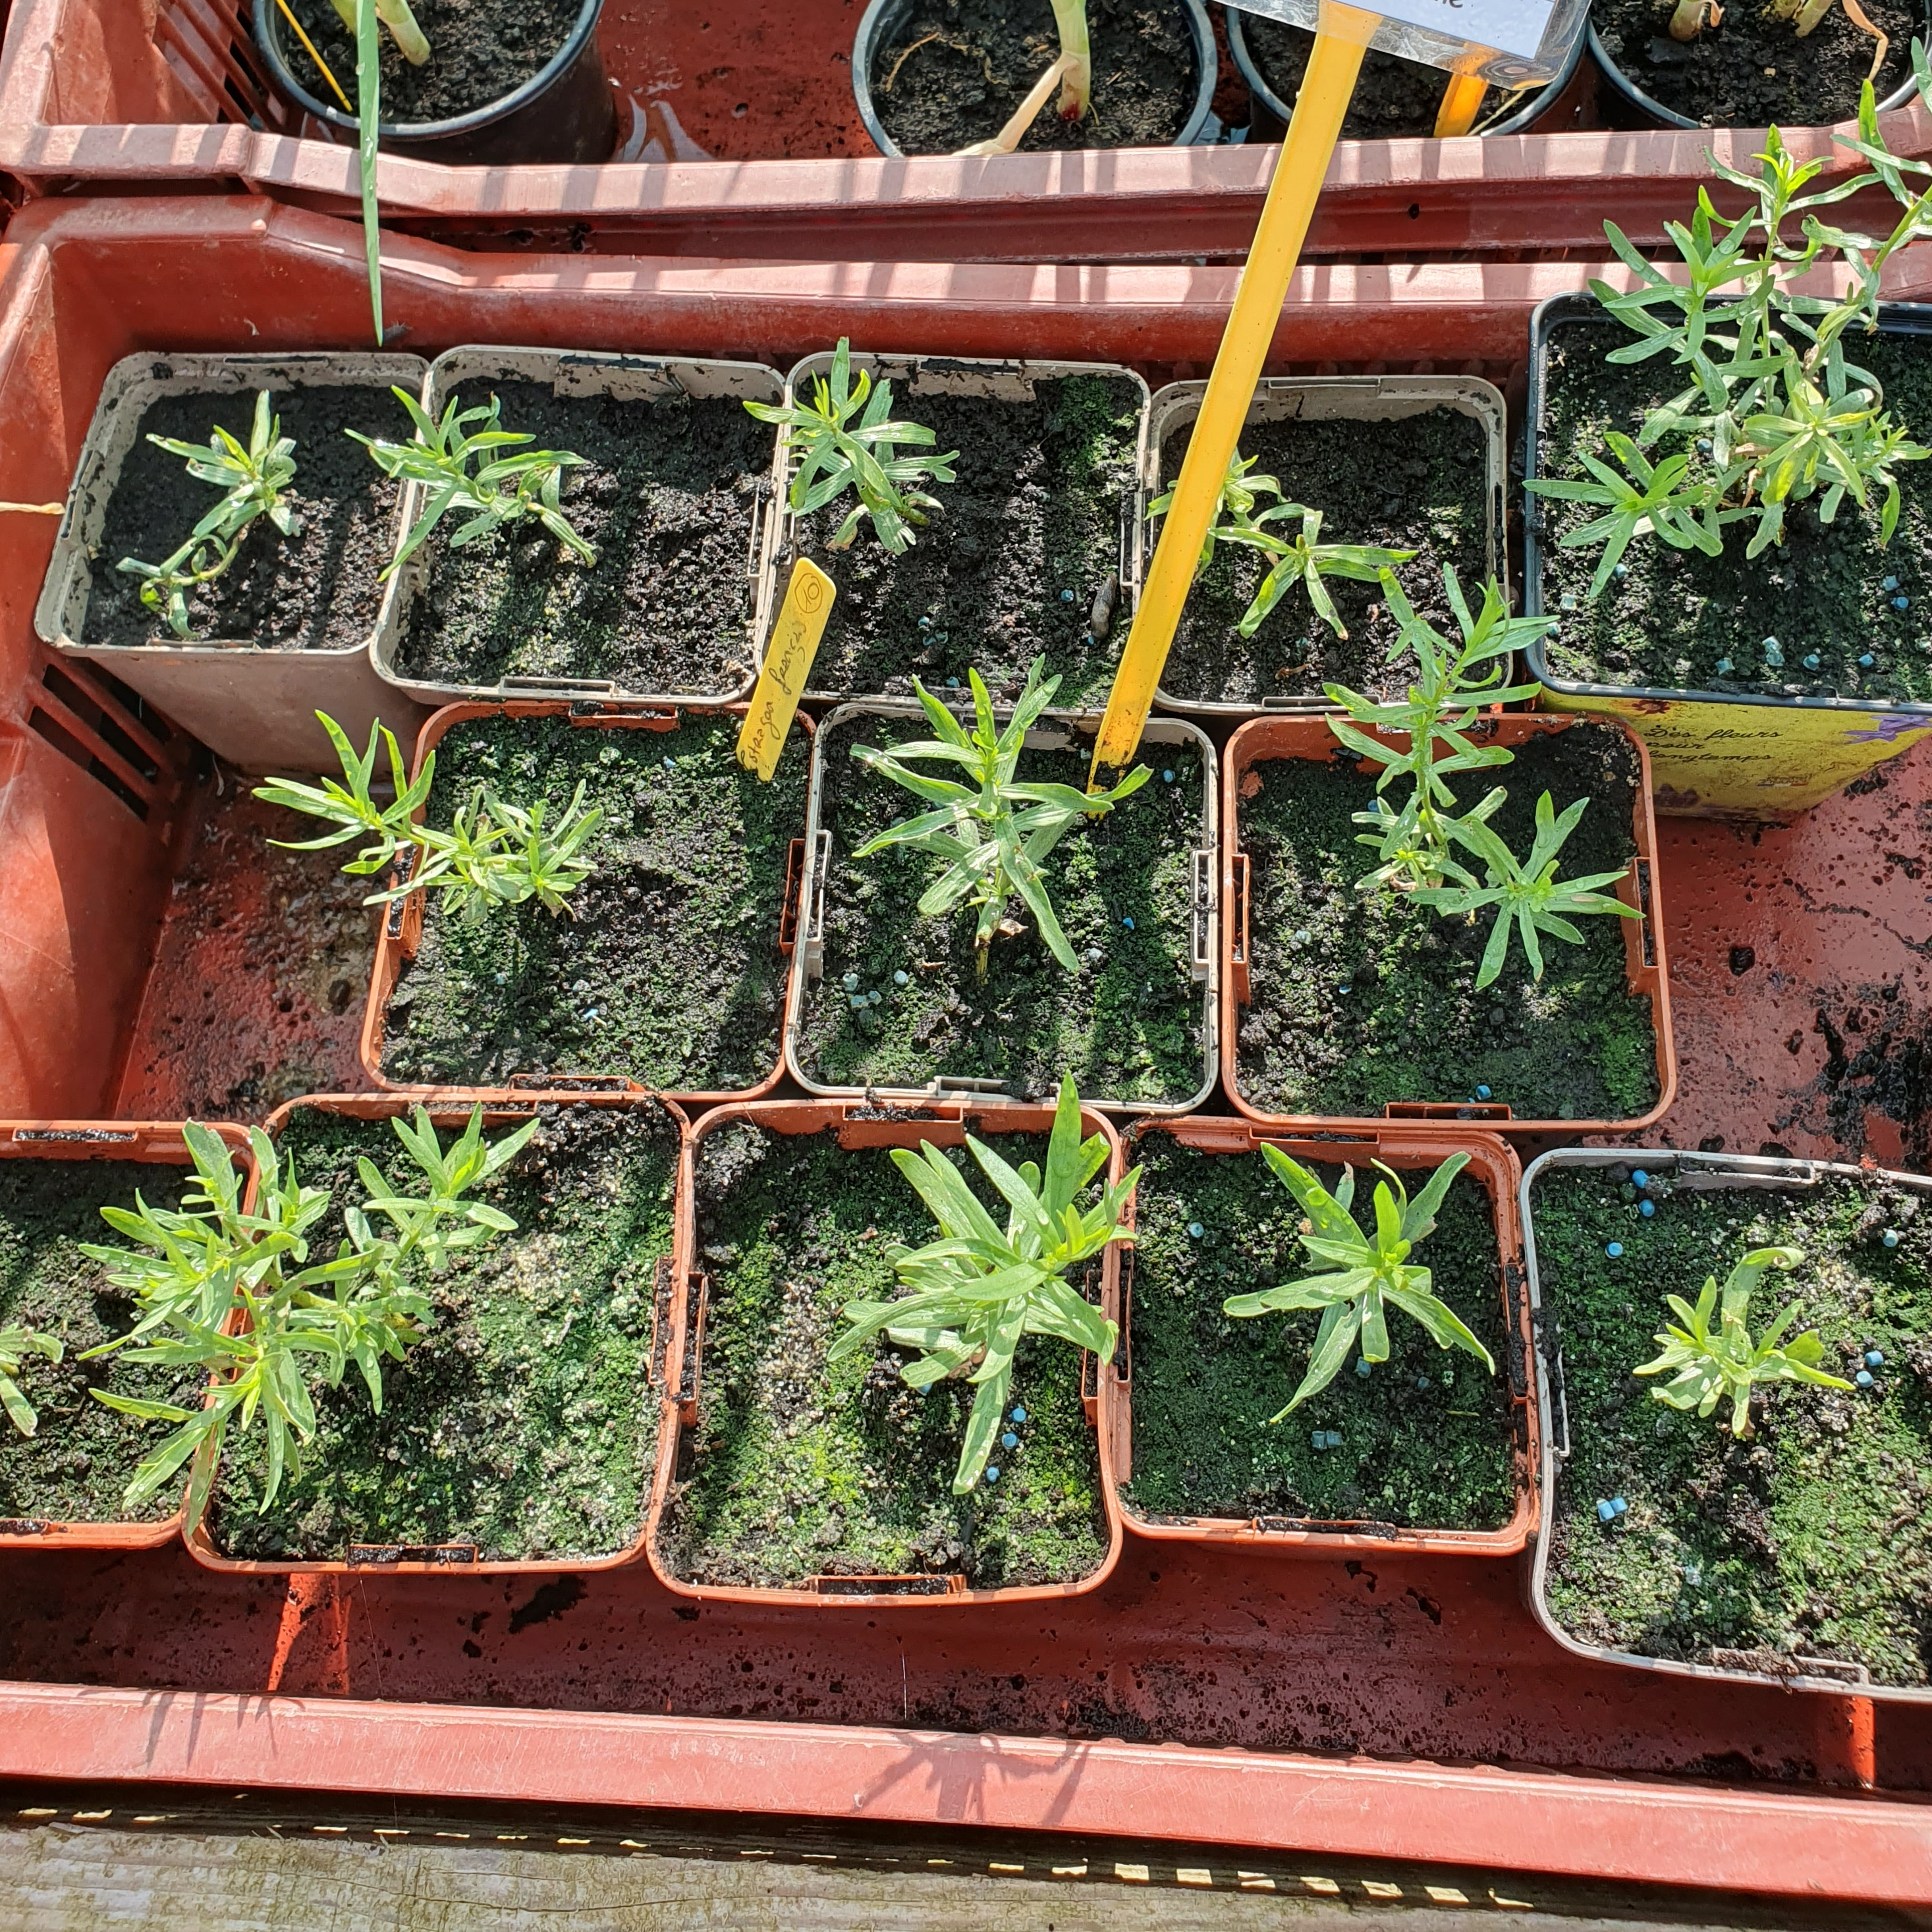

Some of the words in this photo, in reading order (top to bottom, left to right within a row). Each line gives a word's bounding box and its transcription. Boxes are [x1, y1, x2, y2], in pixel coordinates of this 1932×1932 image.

[1643, 727, 1696, 738] Des
[1704, 729, 1783, 740] fleurs
[1649, 750, 1775, 763] longtemps
